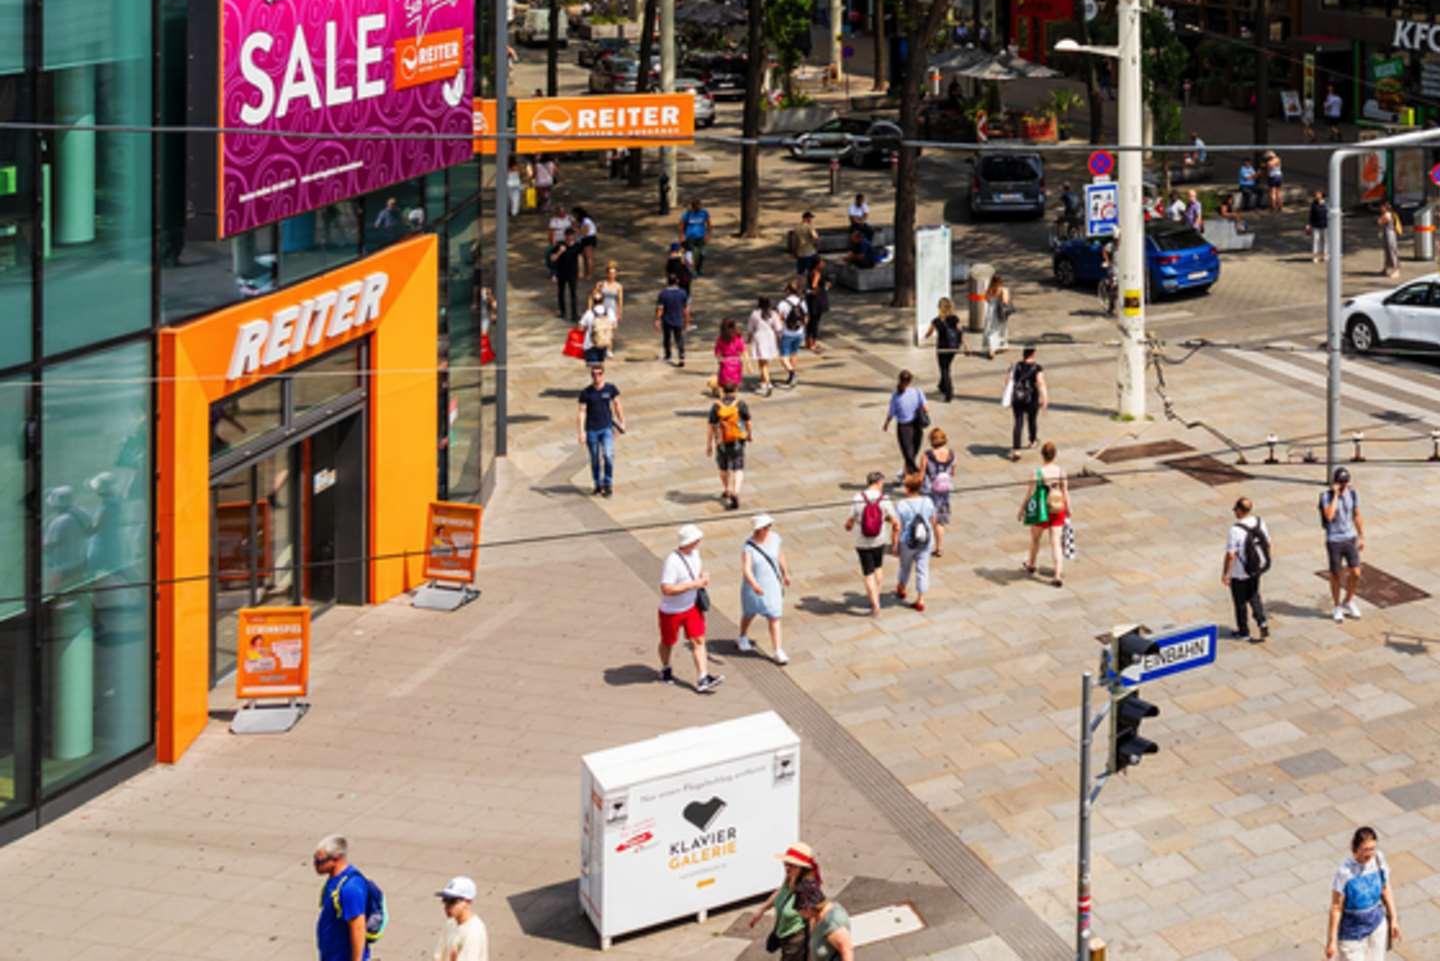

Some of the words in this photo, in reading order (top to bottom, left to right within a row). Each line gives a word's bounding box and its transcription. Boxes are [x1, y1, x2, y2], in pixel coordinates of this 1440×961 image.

[417, 42, 459, 65] REITER
[240, 13, 386, 125] SALE
[577, 106, 680, 129] REITER
[225, 272, 389, 381] REITER
[1144, 638, 1204, 671] EINBAHN
[668, 842, 737, 870] GALERIE
[669, 827, 737, 856] KLAVIER
